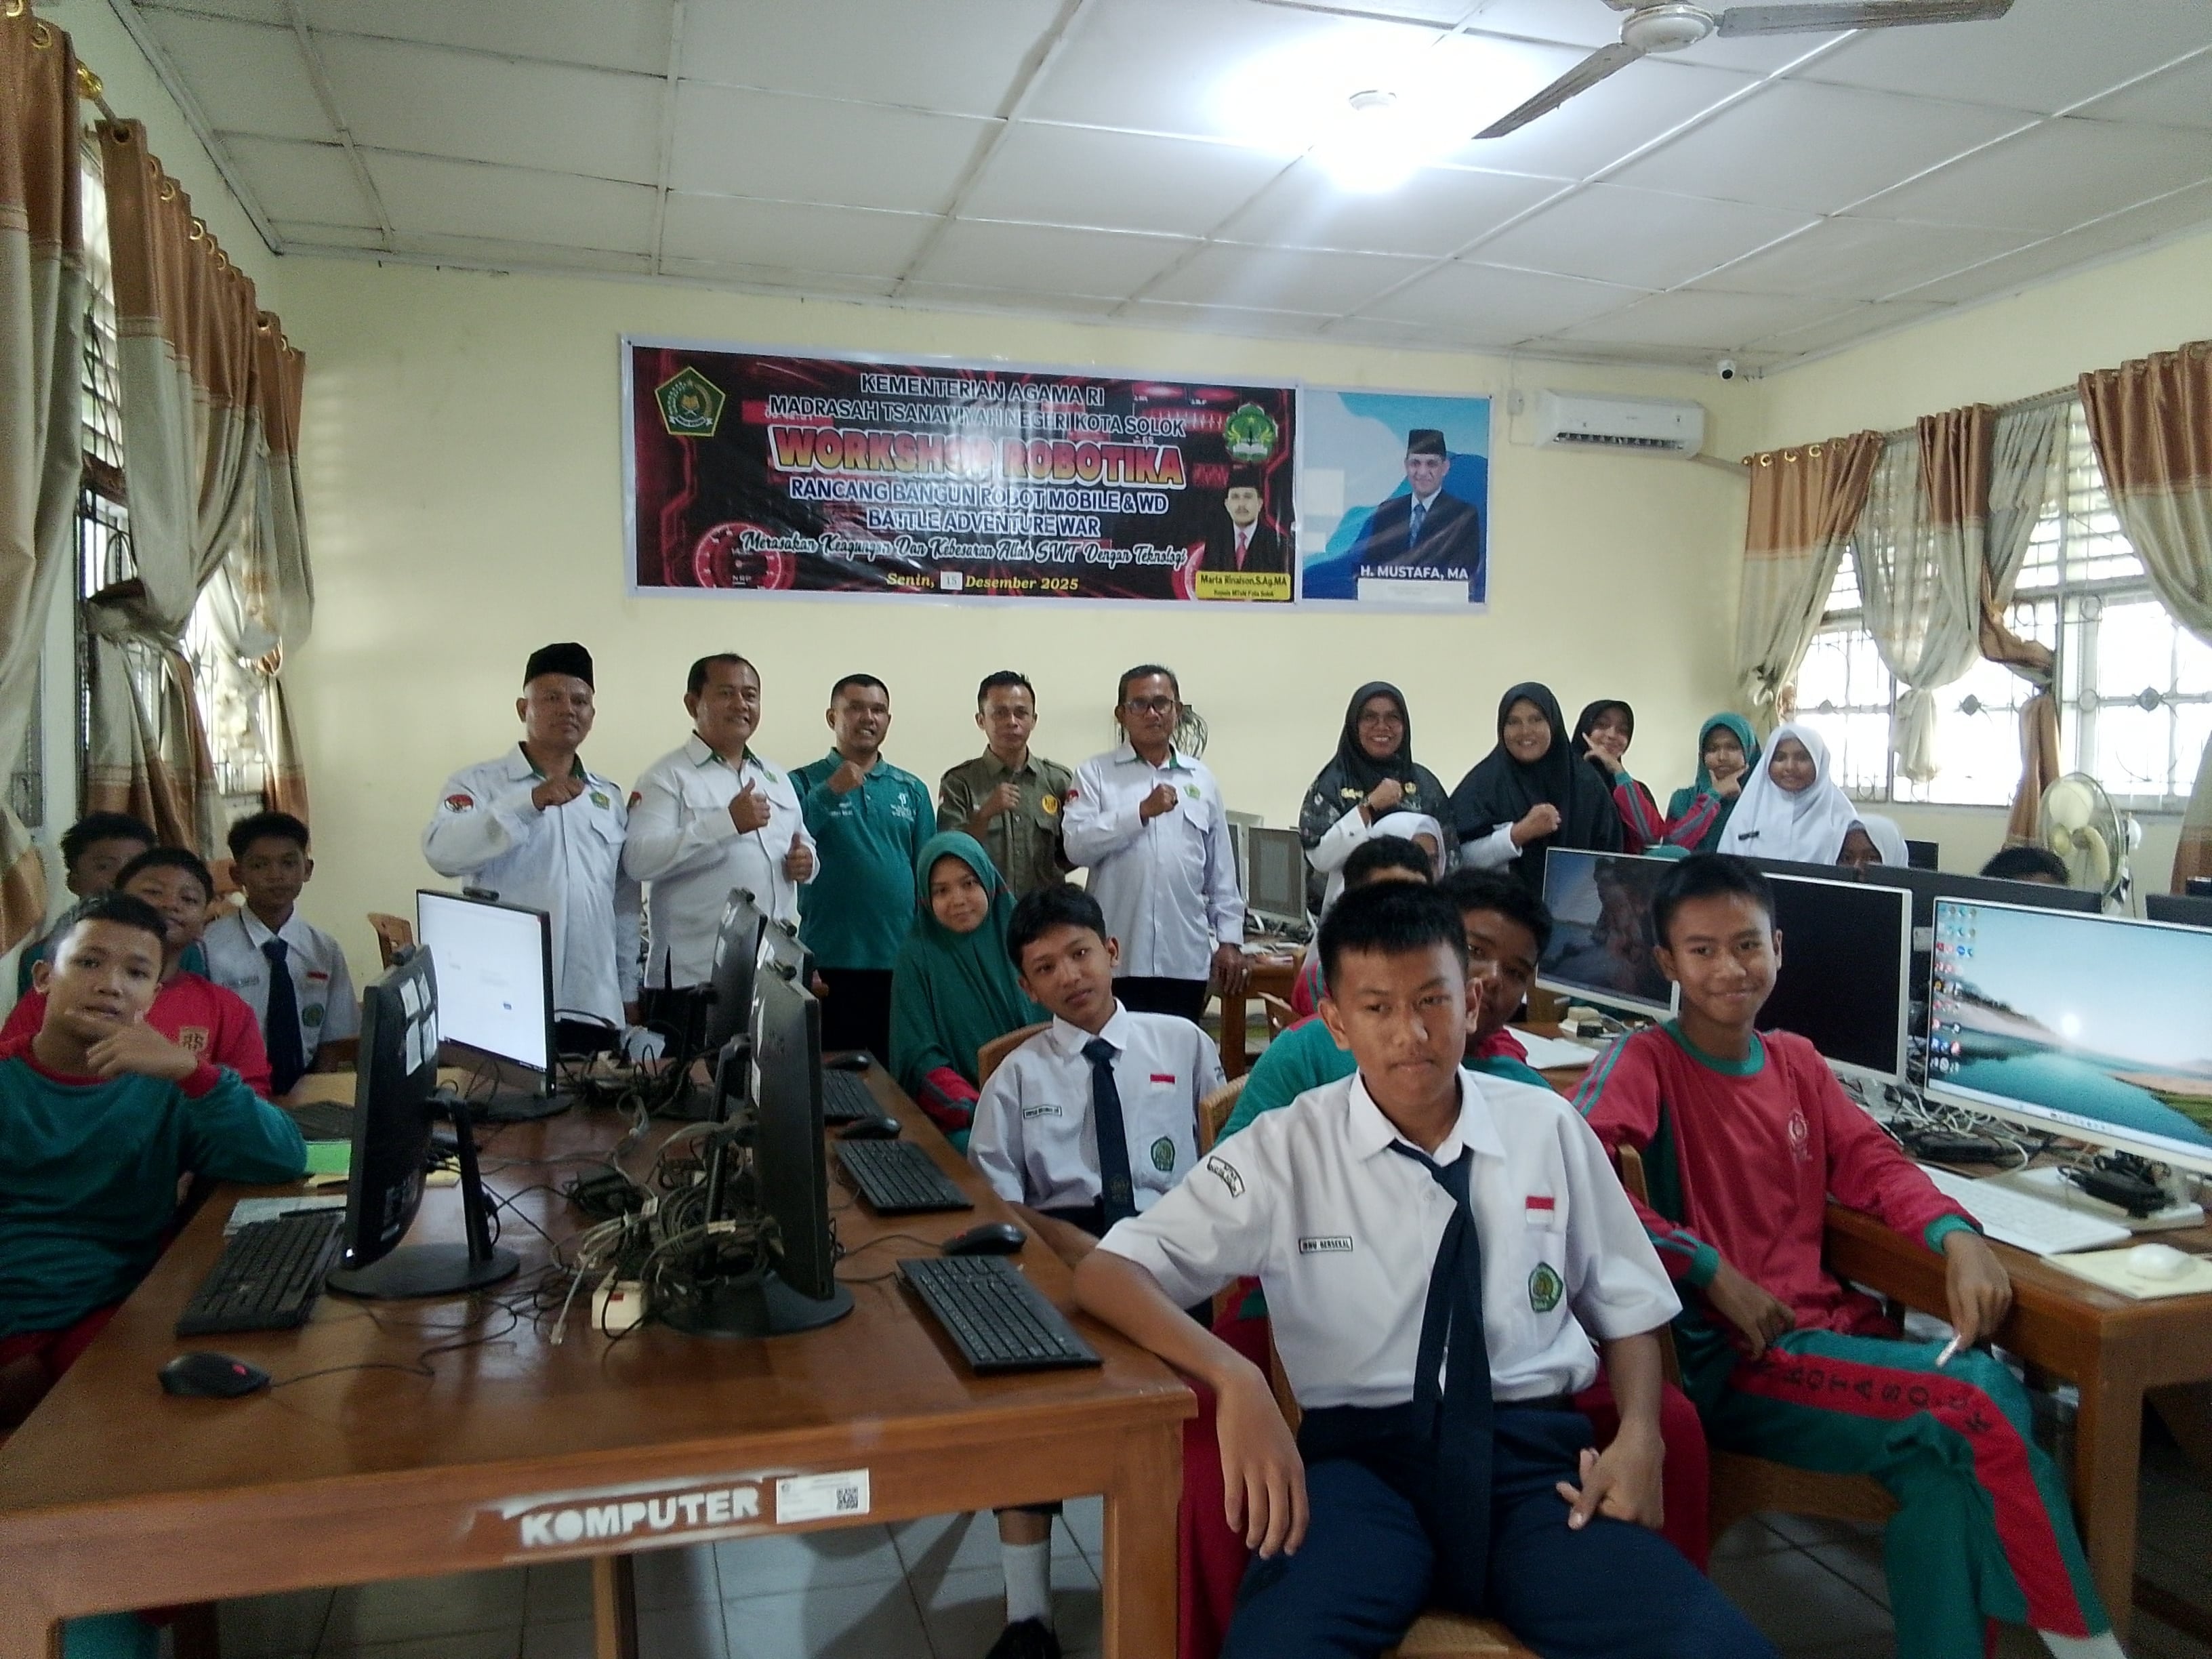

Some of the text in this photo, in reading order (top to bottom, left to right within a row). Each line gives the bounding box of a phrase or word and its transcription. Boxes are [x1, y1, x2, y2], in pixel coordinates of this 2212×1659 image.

[861, 373, 1105, 407] KEMENTERIAN AGAMA RI
[769, 395, 1186, 438] MADRASAH TSANAWIYAH NEGERI KOTA SOLOK
[768, 425, 1187, 489] WORKSHOP ROBOTIKA
[790, 476, 1169, 514] RANCANG BANGUN ROBOT MOBILE & WD
[867, 509, 1101, 537] BATTLE ADVENTURE WAR
[740, 528, 1188, 571] Merasakan Keagungan Dan Kebesaran Allah SWT Dengan Teknologi
[887, 573, 935, 588] Senin,
[966, 576, 1037, 590] Desember
[1041, 577, 1079, 590] 2025
[1360, 565, 1469, 580] H. MUSTAFA, MA
[520, 1486, 760, 1547] KOMPUTER
